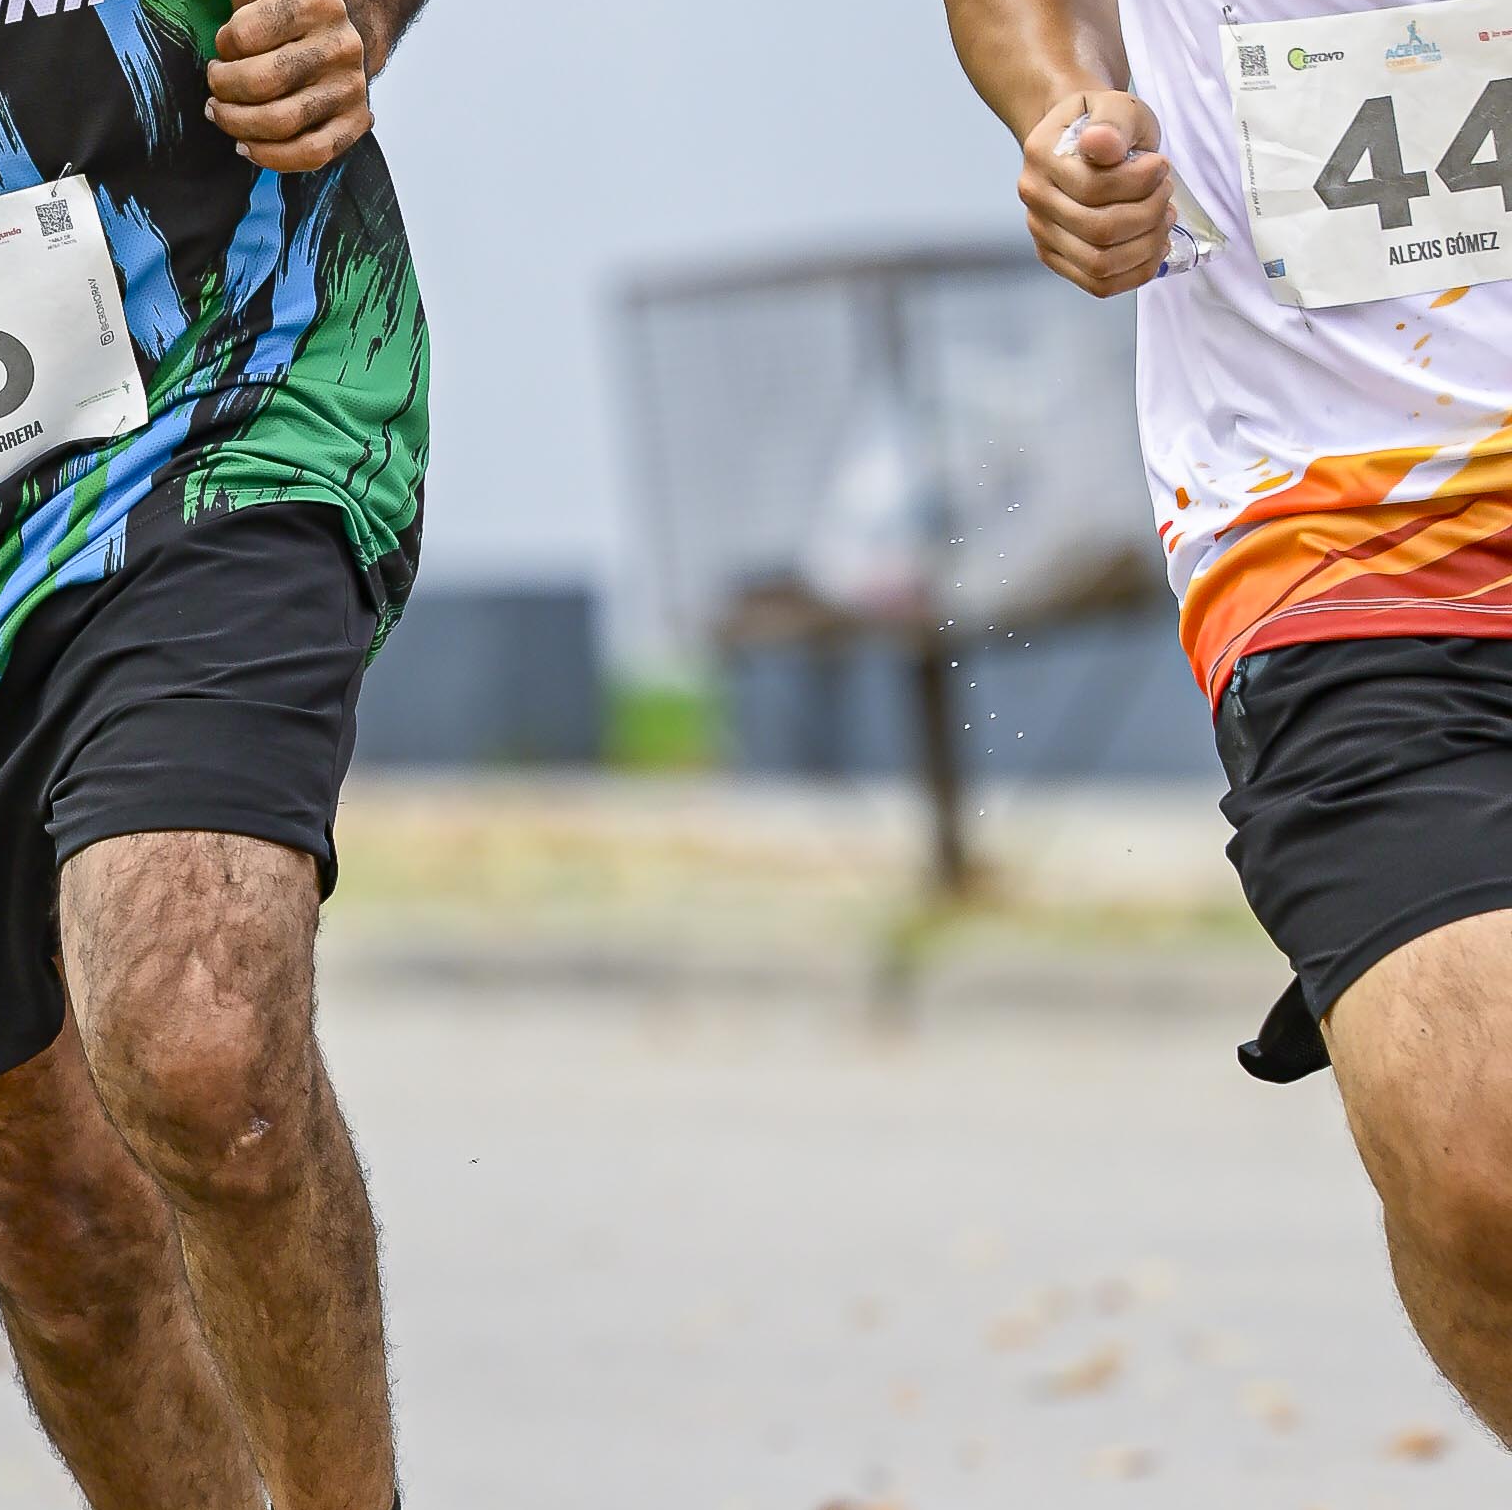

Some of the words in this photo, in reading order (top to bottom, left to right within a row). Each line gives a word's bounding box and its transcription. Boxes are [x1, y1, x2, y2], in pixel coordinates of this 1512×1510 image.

[1313, 77, 1512, 230] 44
[1389, 239, 1443, 266] ALEXIS
[1446, 231, 1500, 256] GÓMEZ
